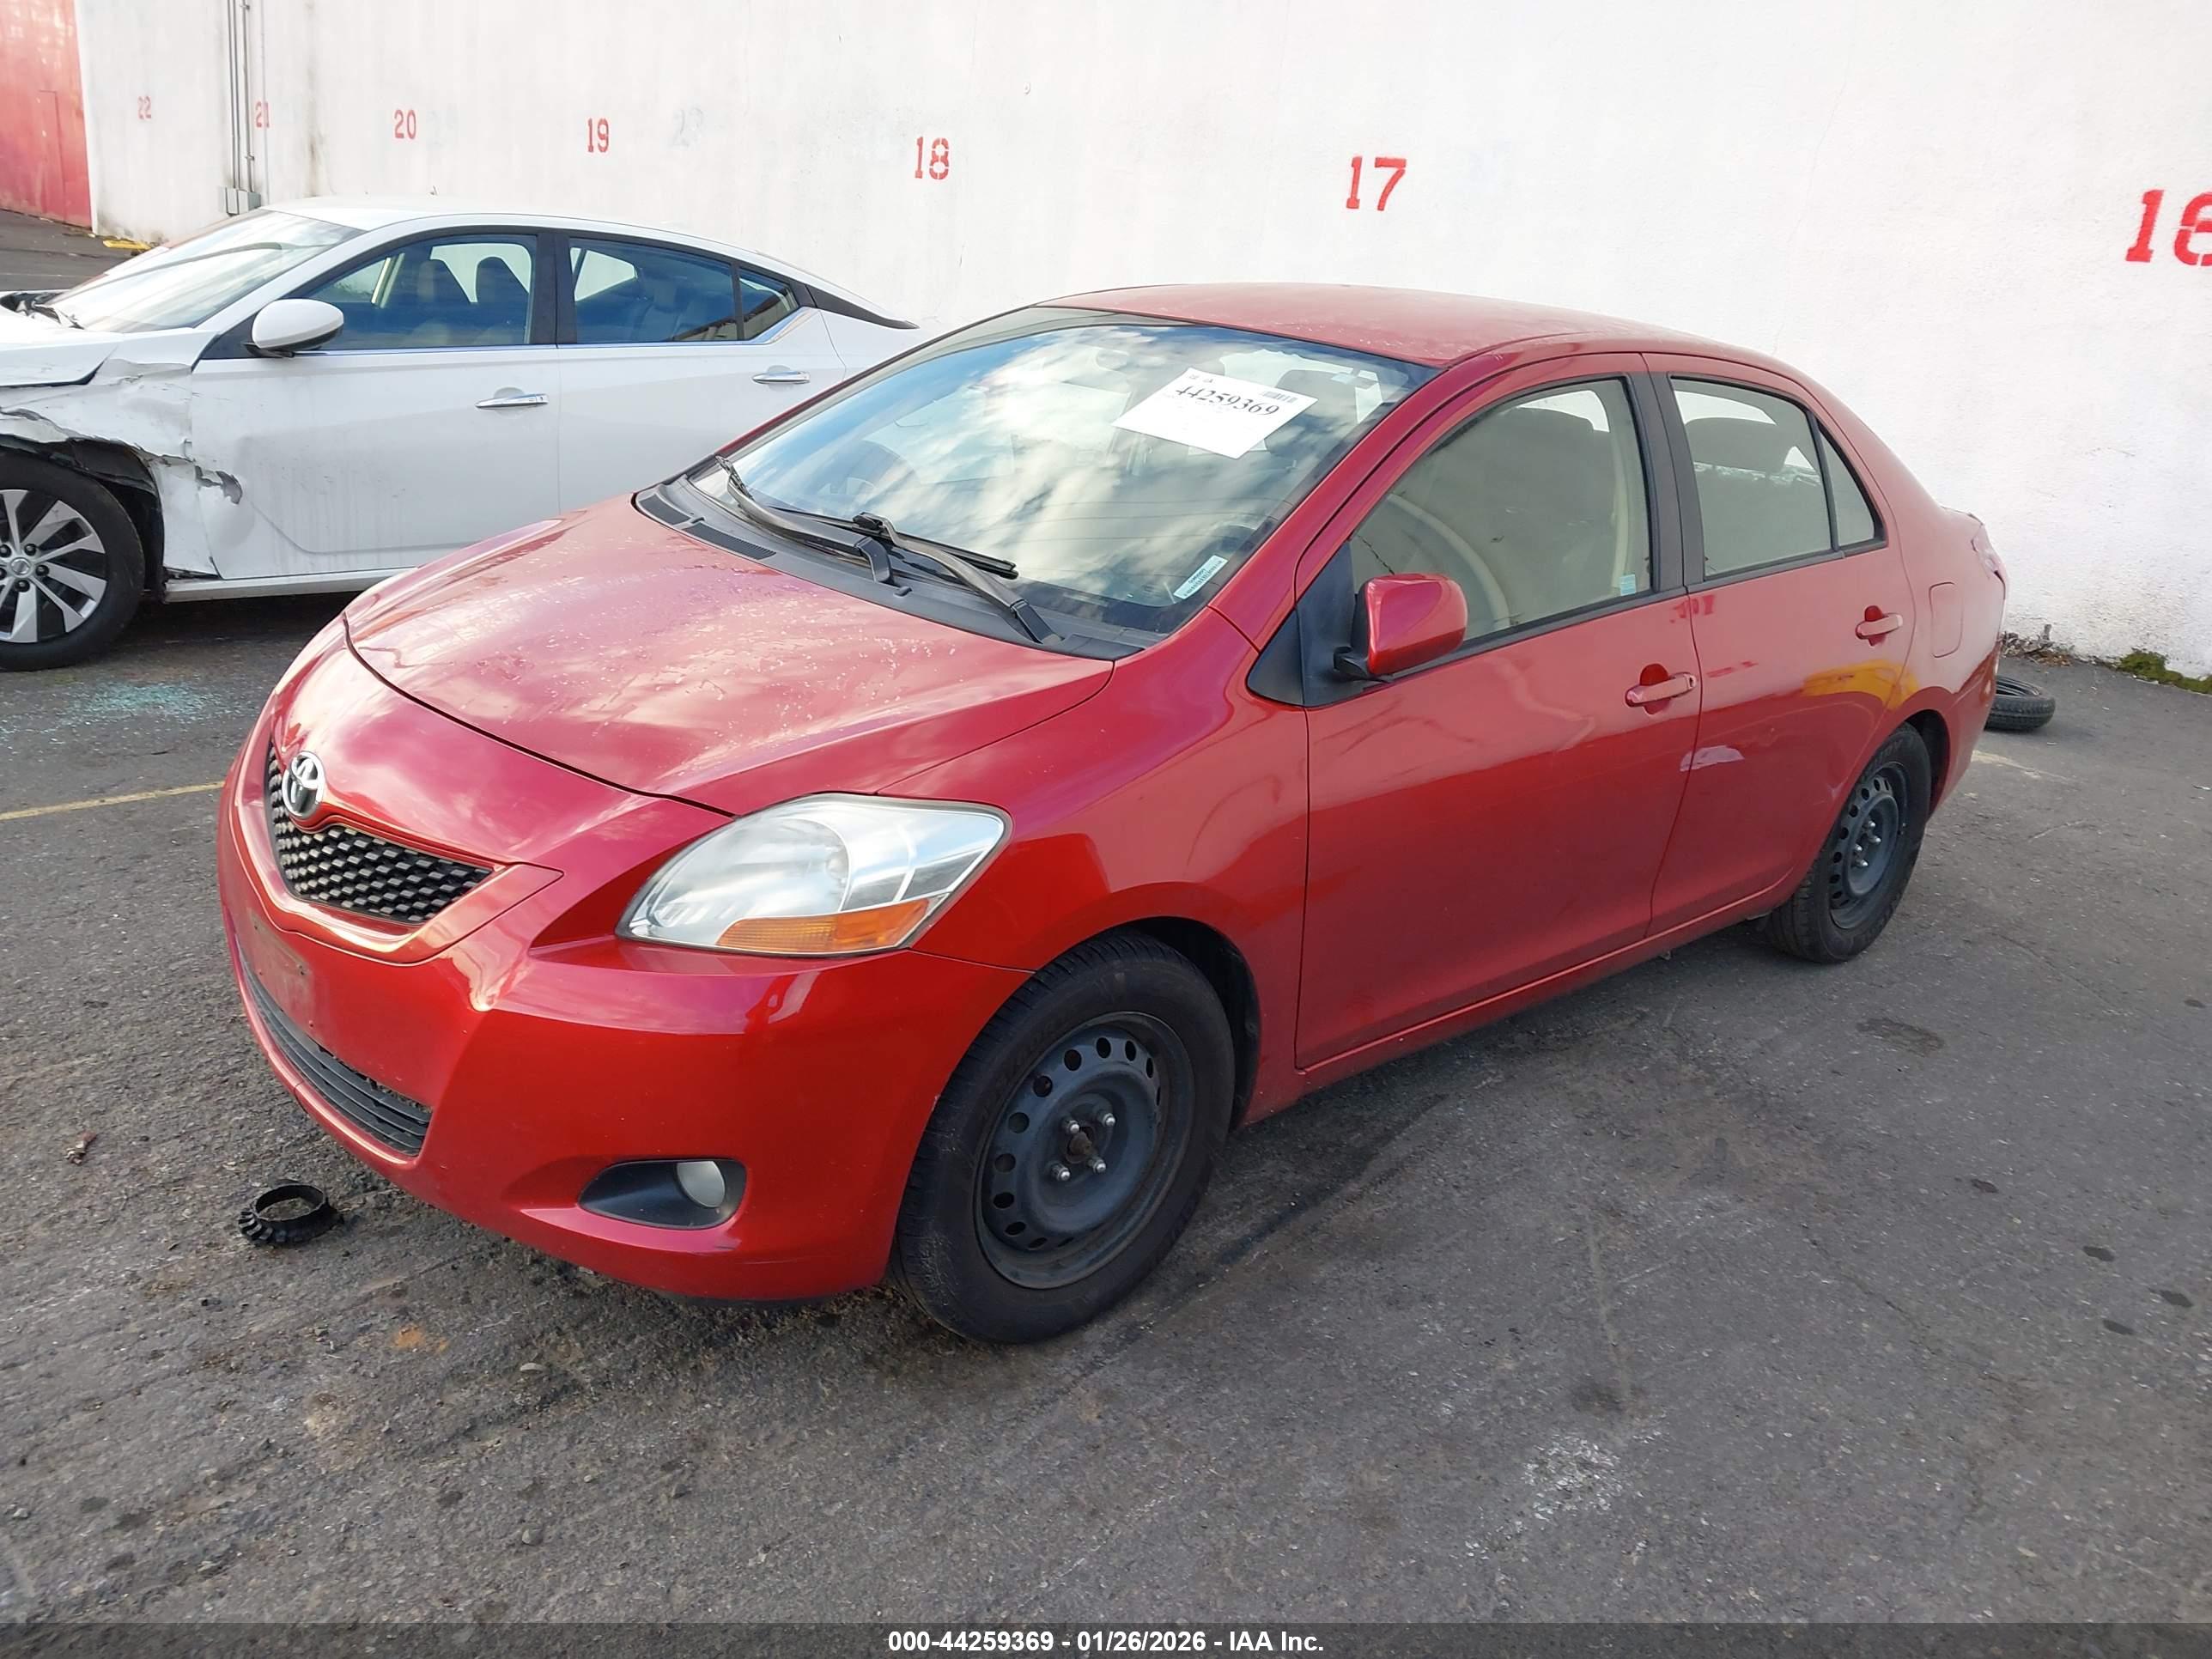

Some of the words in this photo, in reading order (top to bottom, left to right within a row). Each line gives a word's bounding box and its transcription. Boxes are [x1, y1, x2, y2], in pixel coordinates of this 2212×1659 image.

[137, 96, 152, 120] 22
[255, 102, 270, 130] 21
[395, 110, 416, 139] 20
[587, 118, 610, 152] 19
[915, 137, 950, 180] 18
[1345, 155, 1407, 212] 17
[1175, 385, 1280, 416] 44259369
